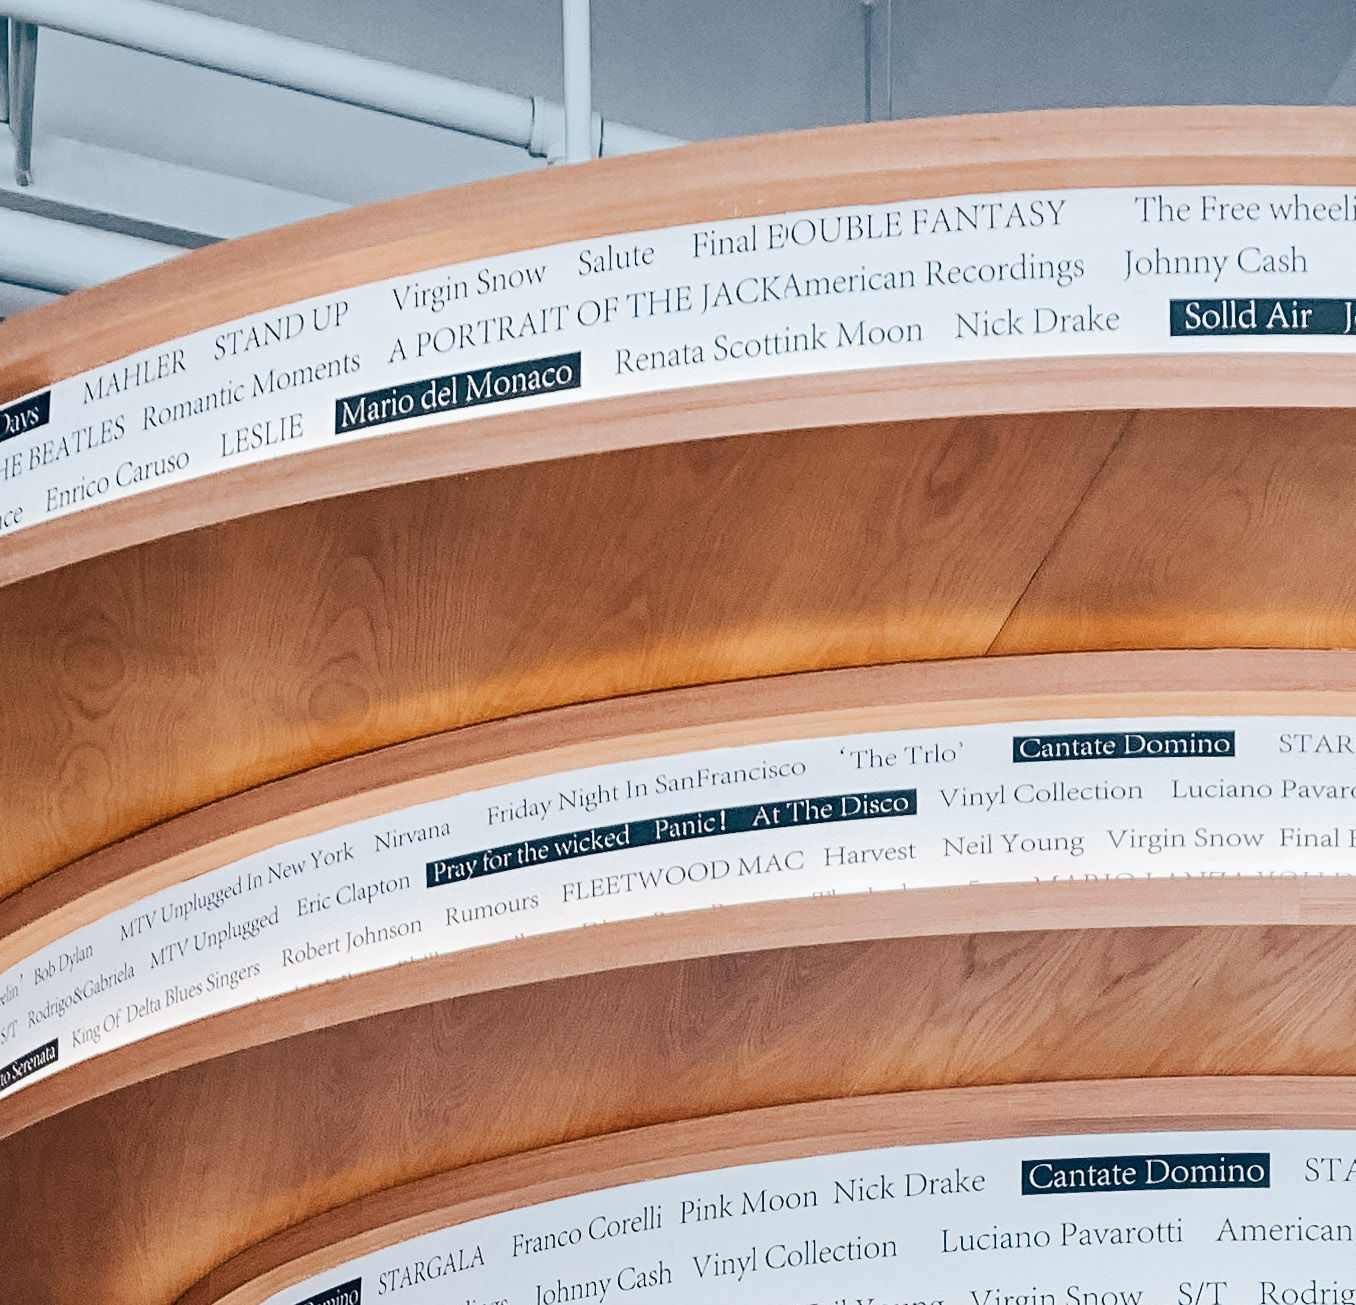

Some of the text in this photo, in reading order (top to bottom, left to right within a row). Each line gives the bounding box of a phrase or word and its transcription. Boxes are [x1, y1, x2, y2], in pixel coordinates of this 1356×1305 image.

[1135, 195, 1190, 222] The
[1202, 196, 1260, 220] Free
[393, 266, 545, 312] Virgin Snow
[389, 286, 691, 363] A PORTRAIT OF THE
[1266, 302, 1312, 329] Air
[84, 302, 348, 404] MAHLER STAND UP
[340, 362, 573, 427] Mario del Monaco
[1020, 734, 1230, 758] Cantate Domino
[434, 794, 909, 883] Pray for the wicked Panic! At The Disco
[1029, 1158, 1265, 1189] Cantate Domino
[693, 1236, 896, 1282] Vinyl Collection
